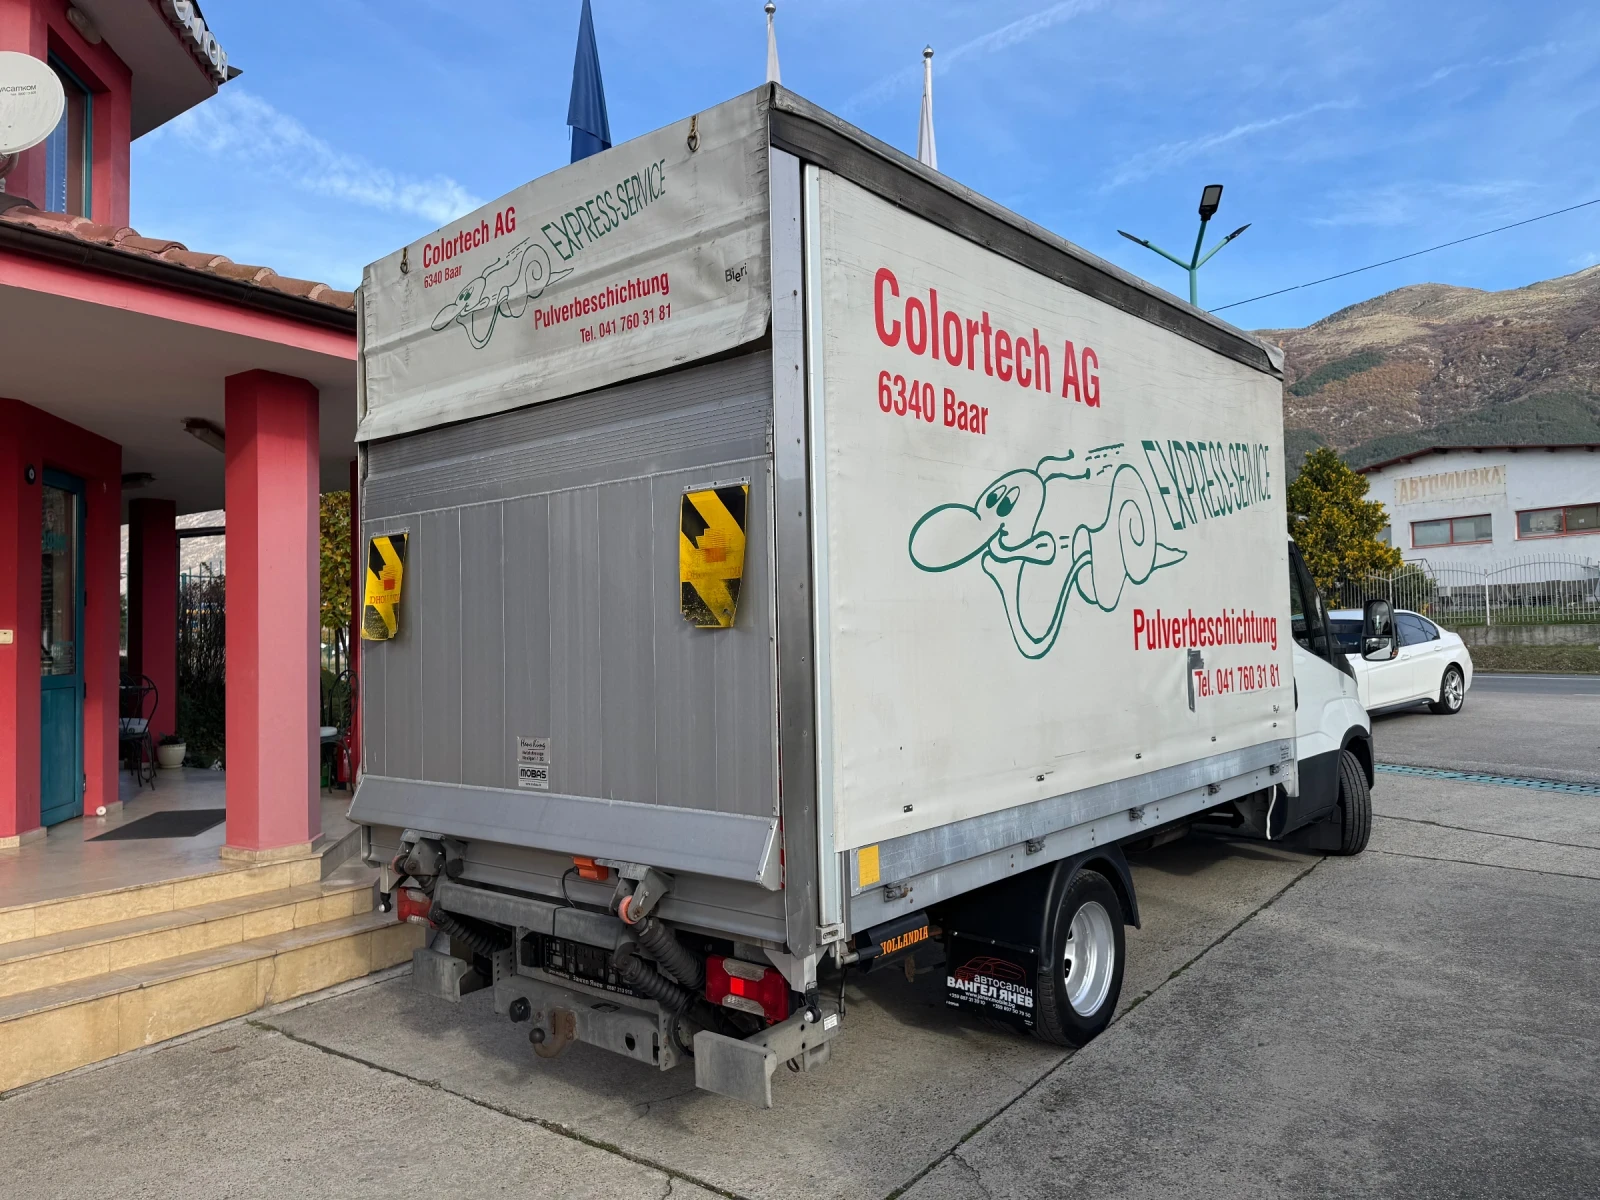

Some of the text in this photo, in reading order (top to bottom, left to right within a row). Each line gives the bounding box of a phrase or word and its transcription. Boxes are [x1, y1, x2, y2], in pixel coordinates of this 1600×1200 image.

[541, 158, 665, 260] EXPRESS-SERVICE
[423, 206, 516, 268] Colortech AG
[424, 265, 462, 289] 6340 Baar
[725, 262, 747, 282] Bieri
[534, 272, 669, 330] Pulverbeschichtung
[580, 303, 671, 343] Tel. 041 760 31 81
[874, 267, 1100, 408] Colortech AG
[878, 370, 989, 435] 6340 Baar
[1141, 440, 1271, 530] EXPRESS-SERVICE
[1400, 468, 1503, 502] АВТОМИВКА
[1133, 609, 1277, 650] Pulverbeschichtung
[1194, 664, 1280, 697] Tel. 041 760 31 81
[521, 768, 546, 779] MOBAS
[874, 925, 929, 958] HOLLANDIA
[947, 976, 1034, 1008] ВАНГЕЛ ЯНЕВ
[974, 974, 1033, 996] автосалон
